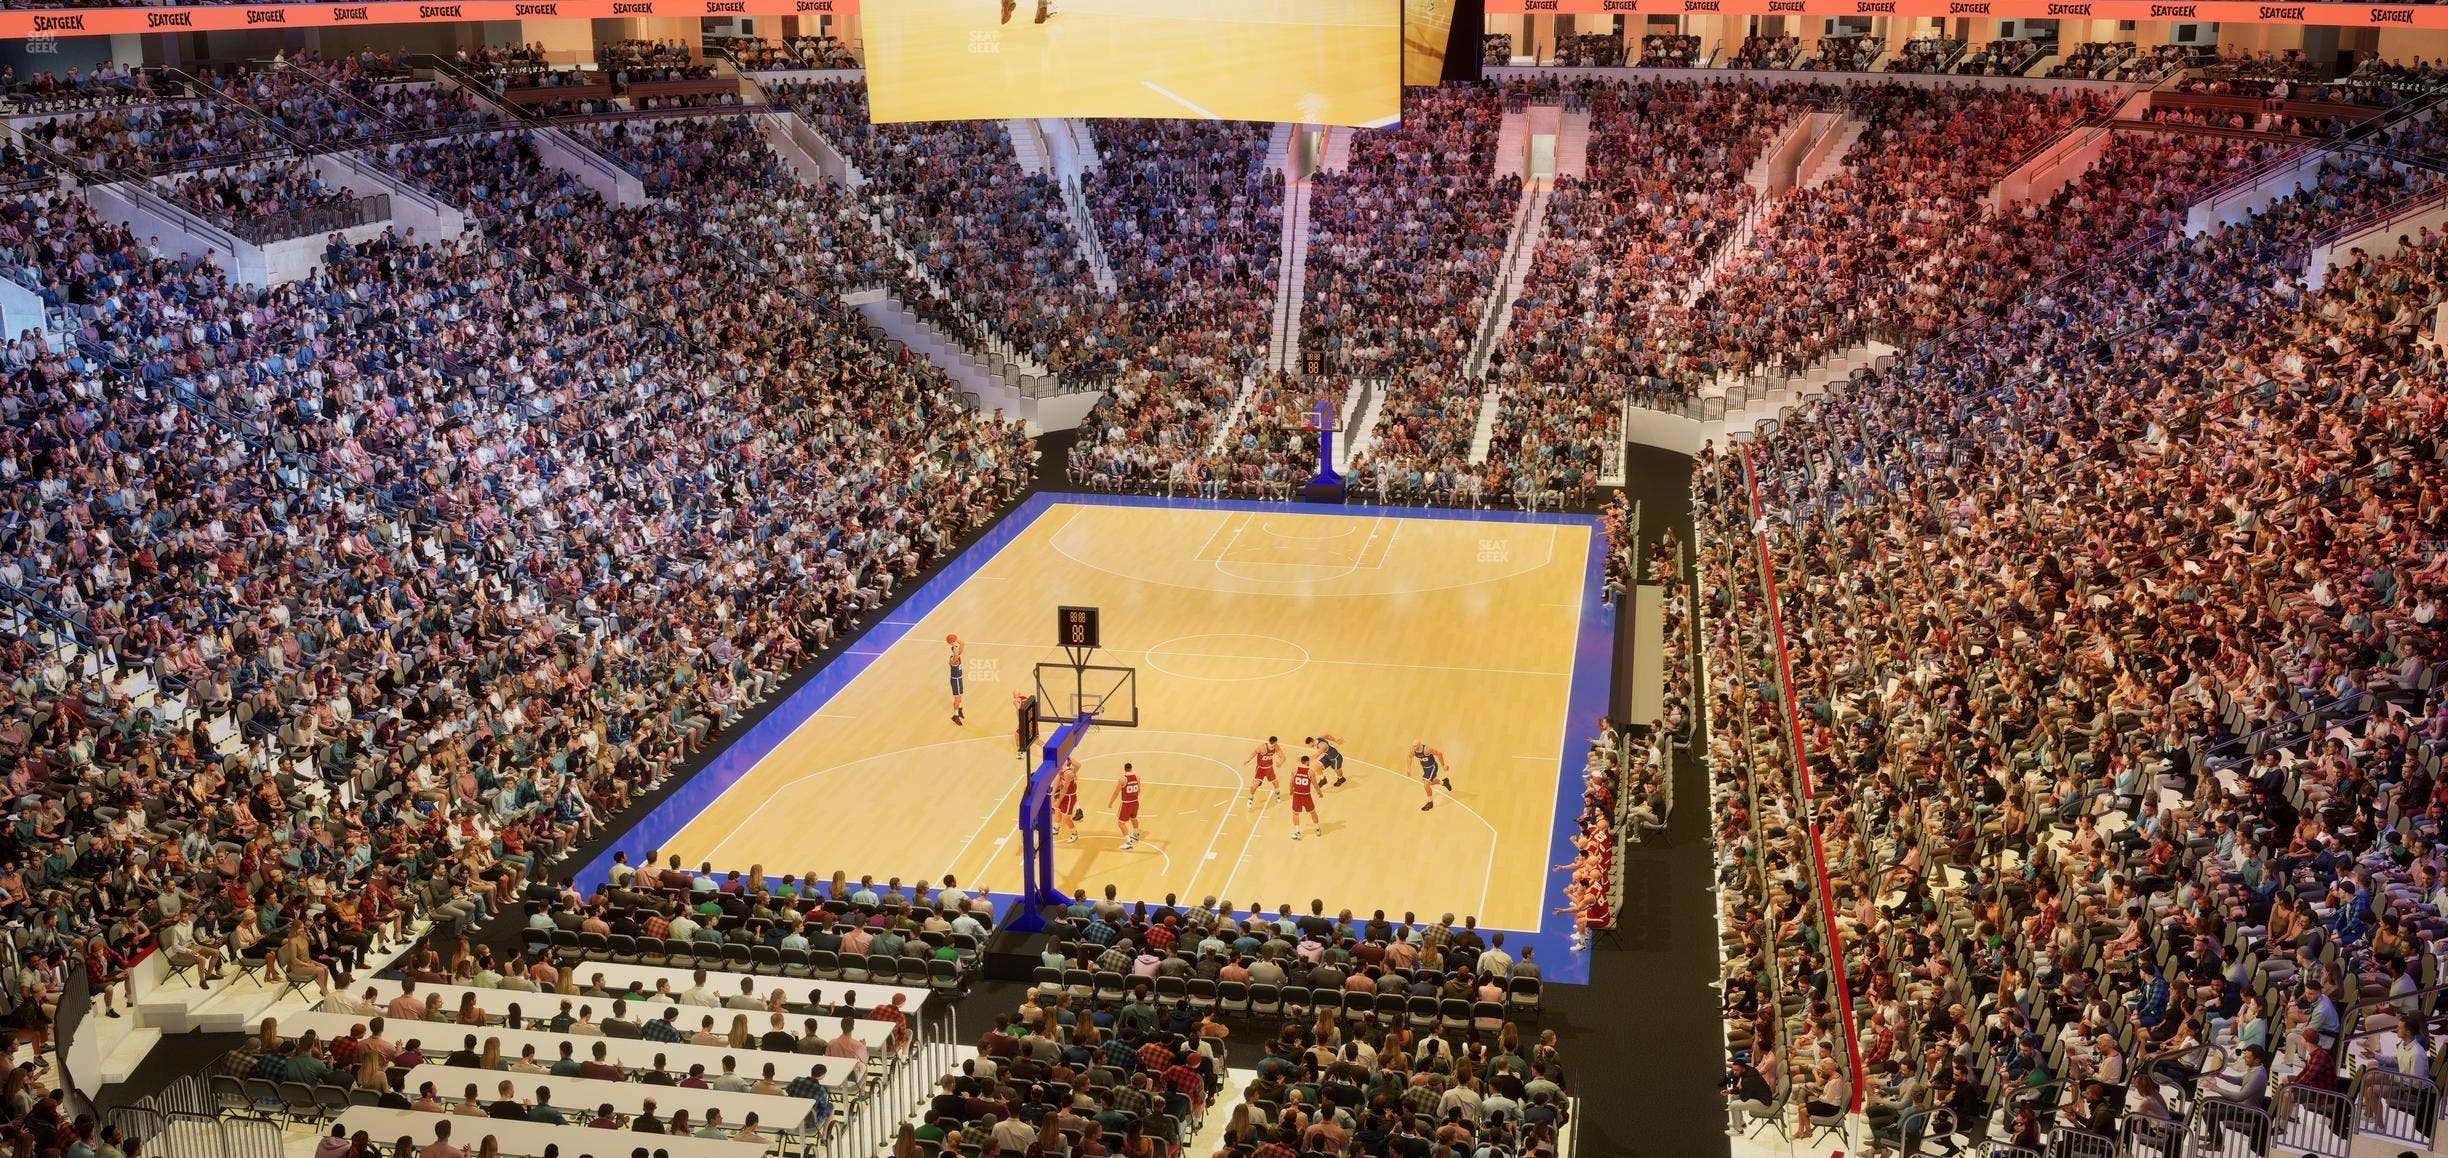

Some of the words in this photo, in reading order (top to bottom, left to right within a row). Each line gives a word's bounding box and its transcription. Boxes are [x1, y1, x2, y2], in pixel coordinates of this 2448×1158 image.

[420, 5, 462, 18] SEATGEEK
[515, 4, 557, 17] SEATGEEK
[613, 2, 653, 15] SEATGEEK
[706, 1, 746, 13] SEATGEEK
[796, 0, 833, 12] SEATGEEK
[1524, 0, 1558, 11] SEATGEEK
[1603, 0, 1637, 11] SEATGEEK
[1684, 0, 1720, 12] SEATGEEK
[1768, 1, 1806, 12] SEATGEEK
[1856, 2, 1896, 13] SEATGEEK
[1949, 3, 1990, 15] SEATGEEK
[2047, 3, 2092, 16] SEATGEEK
[2150, 4, 2197, 18] SEATGEEK
[148, 11, 193, 28] SEATGEEK
[246, 9, 286, 24] SEATGEEK
[333, 7, 368, 21] SEATGEEK
[2259, 6, 2305, 20] SEATGEEK
[2370, 8, 2415, 24] SEATGEEK
[33, 15, 85, 32] SEATGEEK
[1308, 361, 1319, 374] 88
[1072, 625, 1085, 643] 88
[1295, 777, 1309, 786] 00
[1126, 784, 1138, 793] 00
